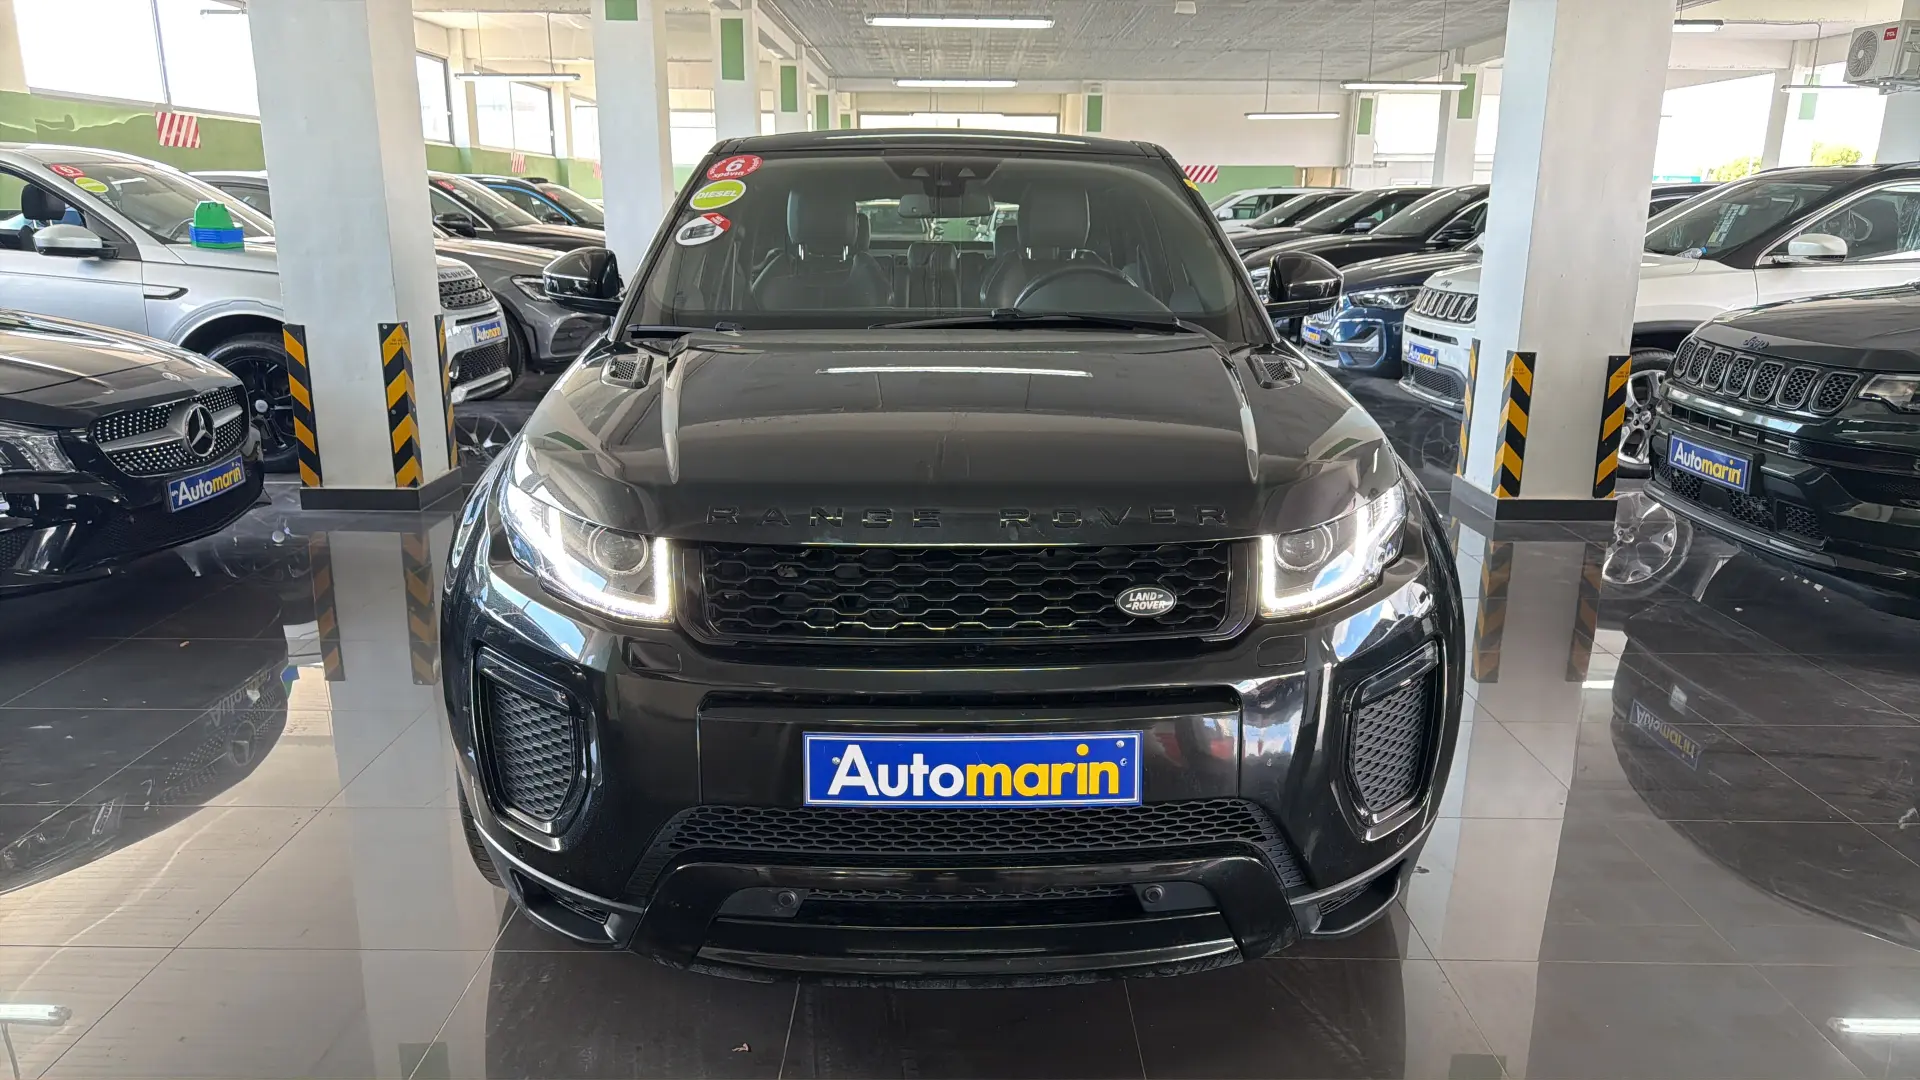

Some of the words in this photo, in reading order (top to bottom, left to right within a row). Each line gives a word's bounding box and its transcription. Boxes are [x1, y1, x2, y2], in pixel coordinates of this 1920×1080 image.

[726, 159, 746, 172] 6
[696, 190, 737, 199] DIESEL
[1743, 336, 1770, 350] Jeep
[1673, 442, 1741, 484] Automarin
[178, 463, 242, 505] Automarin
[706, 505, 942, 528] RANGE
[998, 505, 1228, 529] ROVER
[1129, 592, 1157, 601] LAND
[1131, 600, 1166, 610] ROVER
[827, 743, 1119, 797] Automarin
